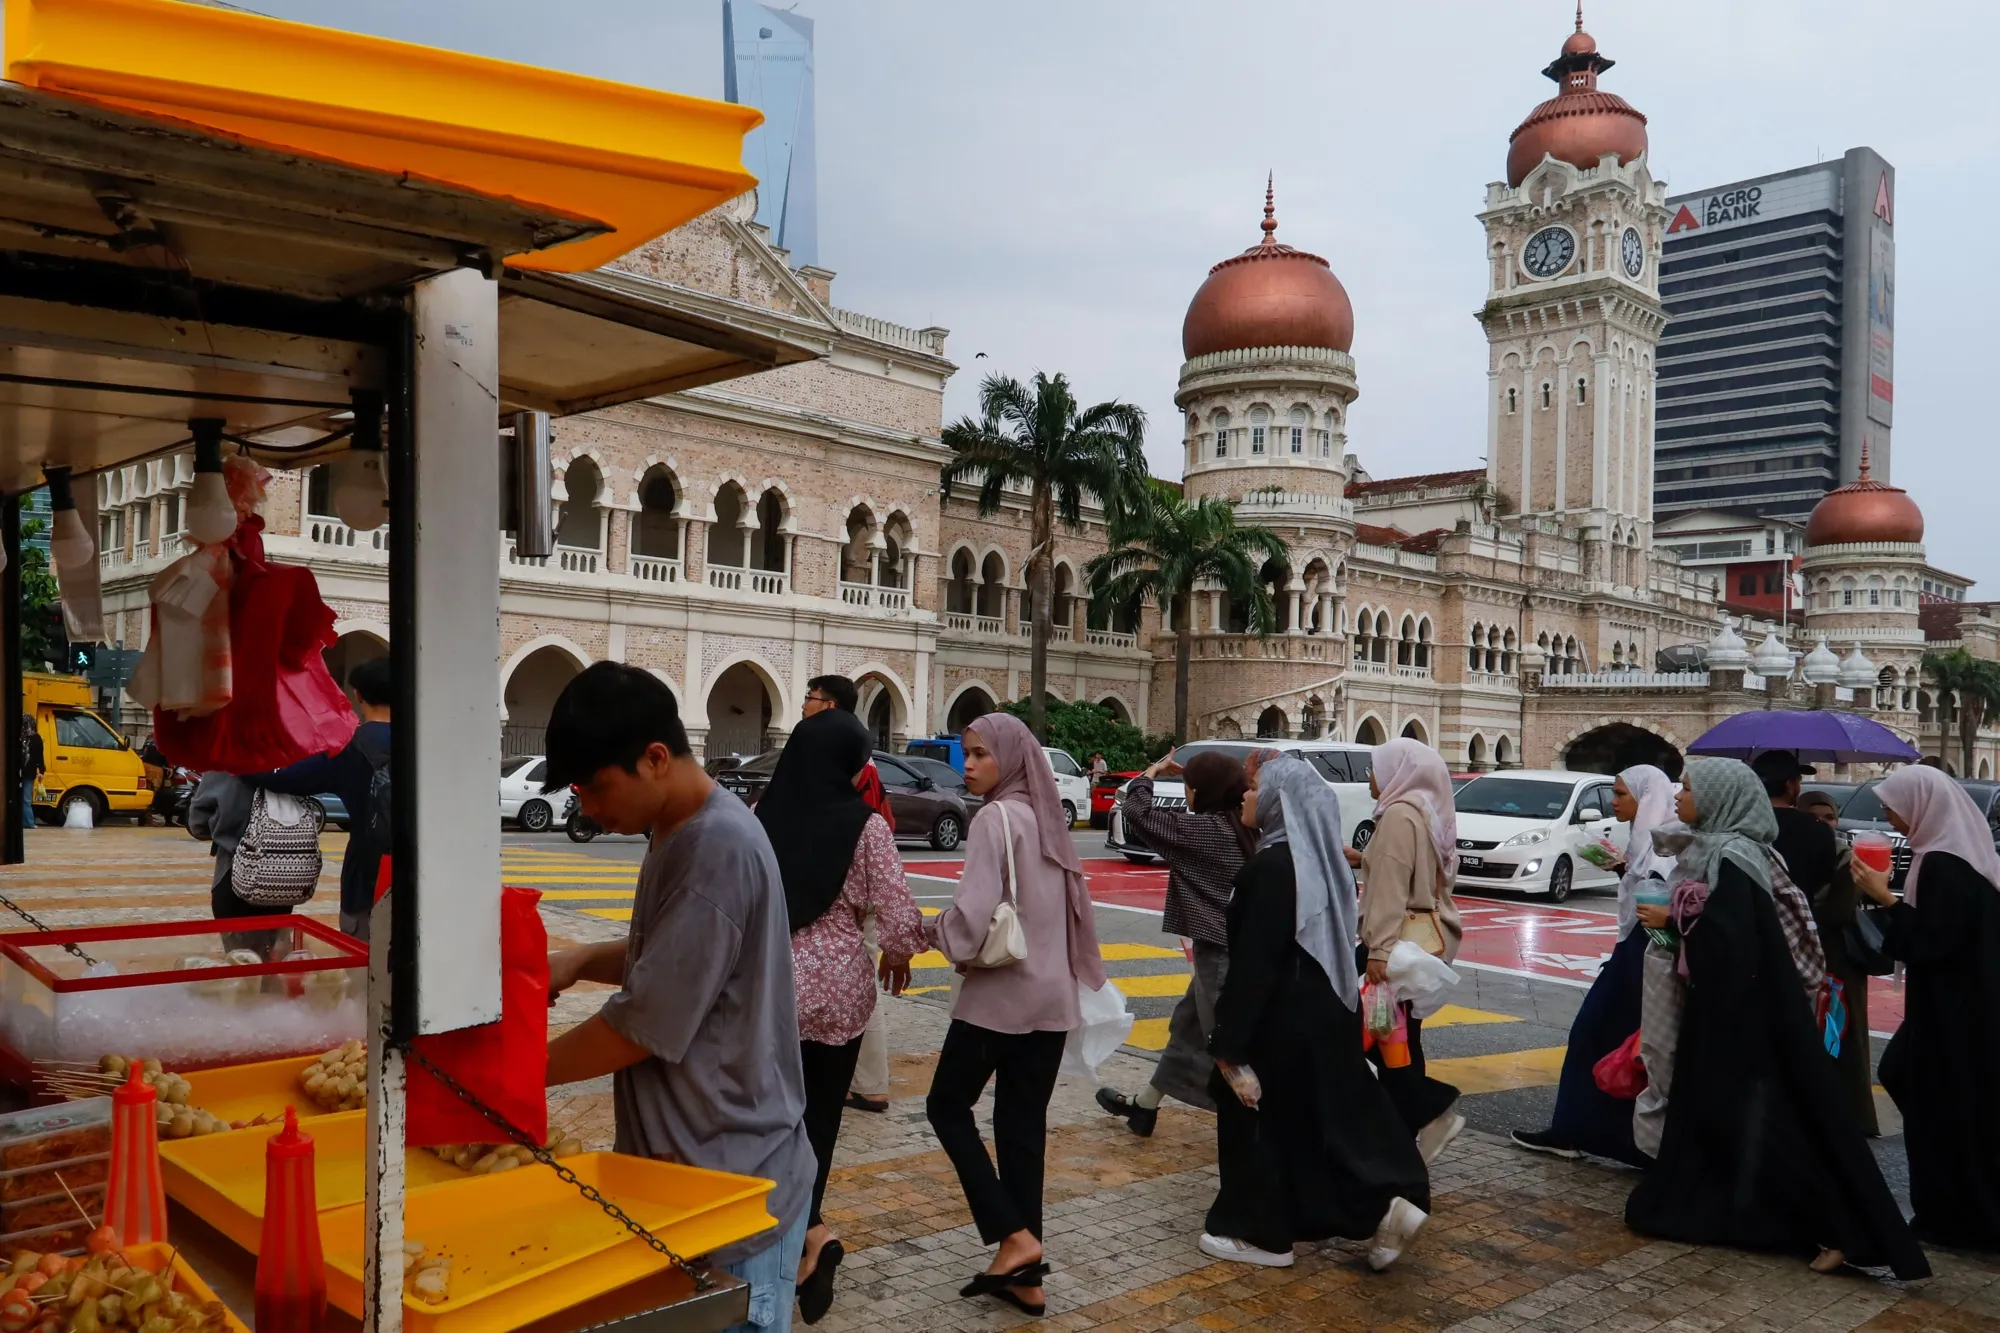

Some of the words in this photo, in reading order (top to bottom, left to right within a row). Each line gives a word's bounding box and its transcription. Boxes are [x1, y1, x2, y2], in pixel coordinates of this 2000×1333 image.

[1708, 187, 1762, 211] AGRO
[1707, 201, 1760, 225] BANK
[1463, 856, 1479, 865] 9438
